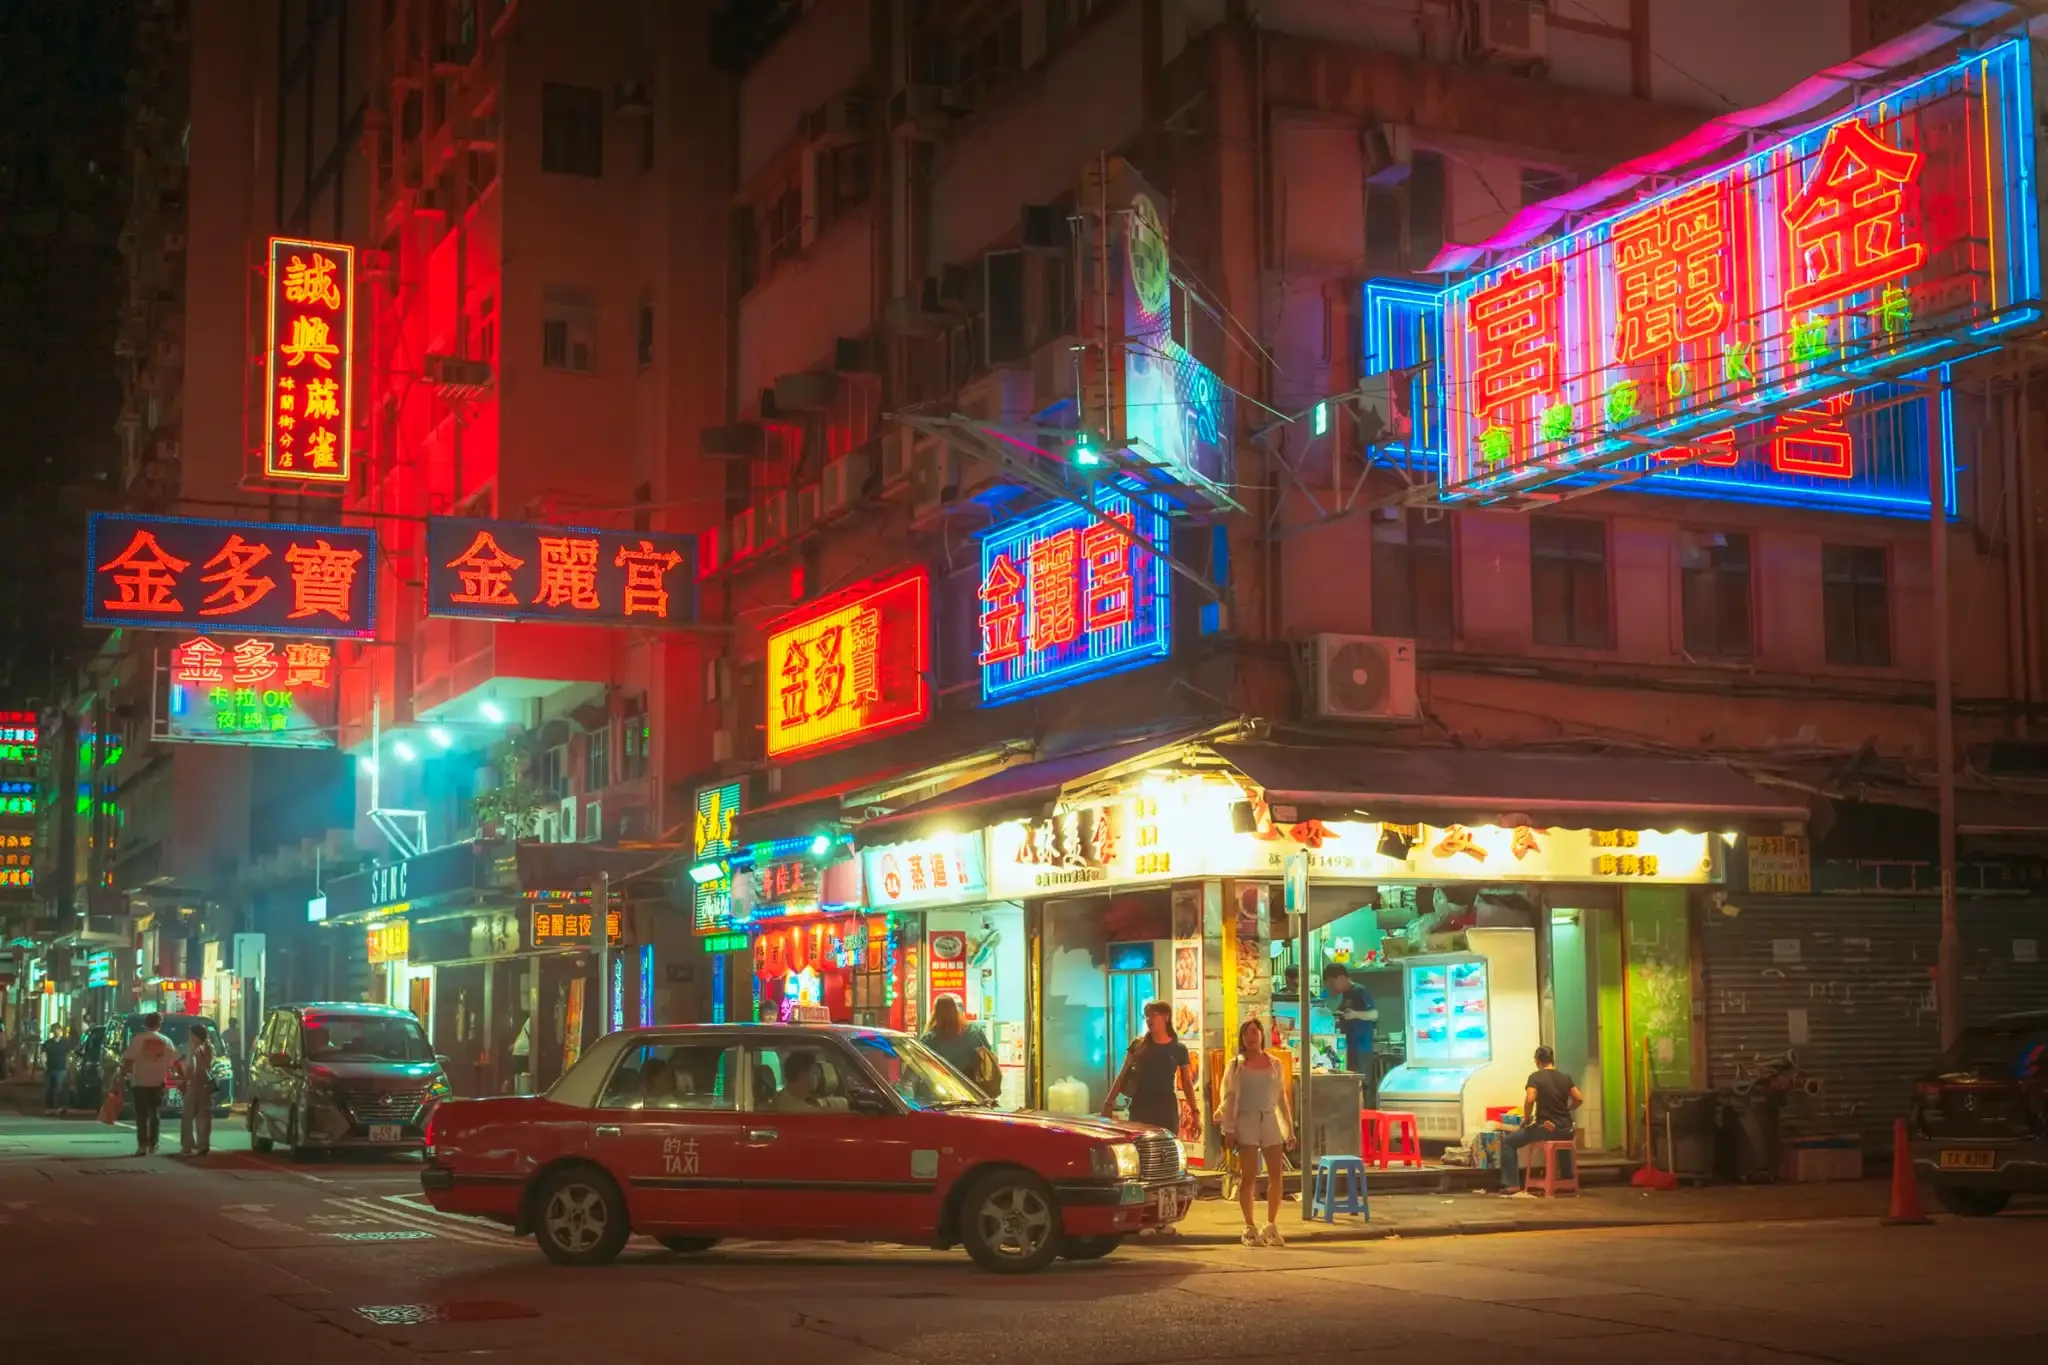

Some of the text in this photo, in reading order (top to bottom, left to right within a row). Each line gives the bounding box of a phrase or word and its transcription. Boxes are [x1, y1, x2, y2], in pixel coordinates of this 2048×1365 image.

[98, 529, 363, 622] 金多寶
[178, 636, 332, 688] 金多寶
[781, 607, 879, 730] 金多寶
[537, 914, 619, 937] 金麗宮夜會
[664, 1137, 699, 1155] 的士
[663, 1155, 699, 1175] TAXI
